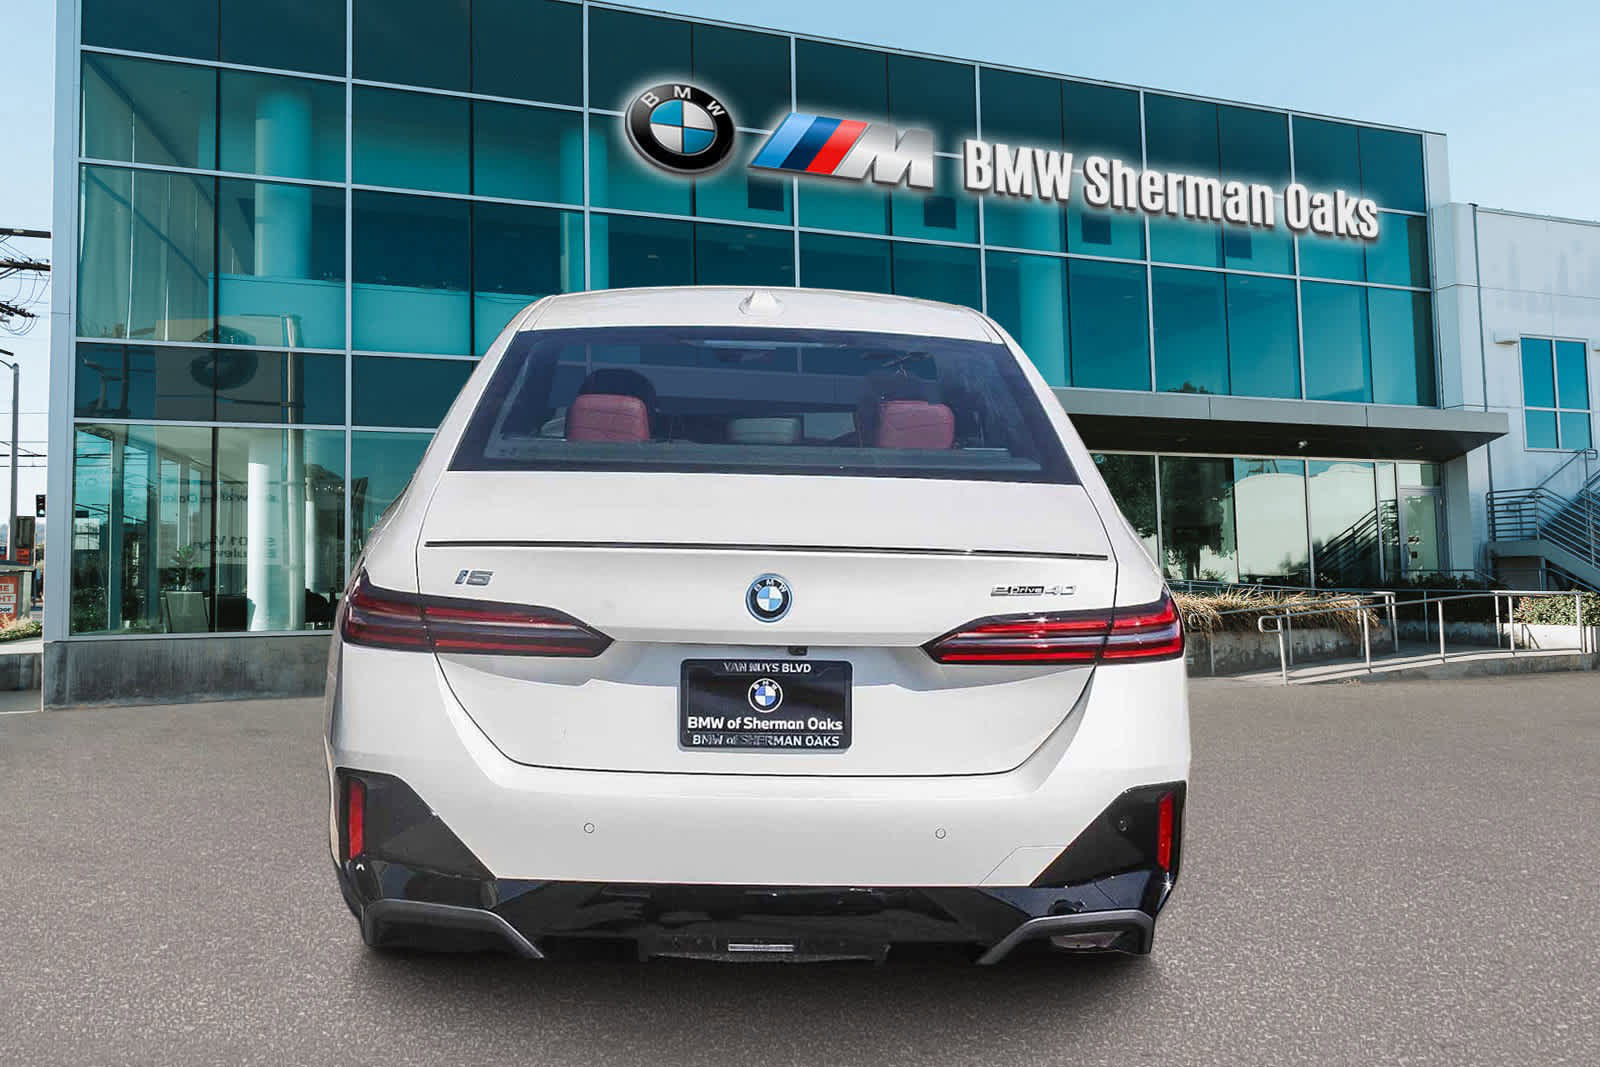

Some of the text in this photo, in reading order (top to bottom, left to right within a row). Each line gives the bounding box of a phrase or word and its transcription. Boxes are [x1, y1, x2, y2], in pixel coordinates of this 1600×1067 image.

[641, 85, 726, 118] BMW
[963, 138, 1381, 242] BMW Sherman Oaks
[781, 663, 812, 673] BLVD
[687, 716, 843, 730] BMW of Sherman Oaks
[692, 734, 724, 745] BMW
[805, 735, 840, 746] OAKS
